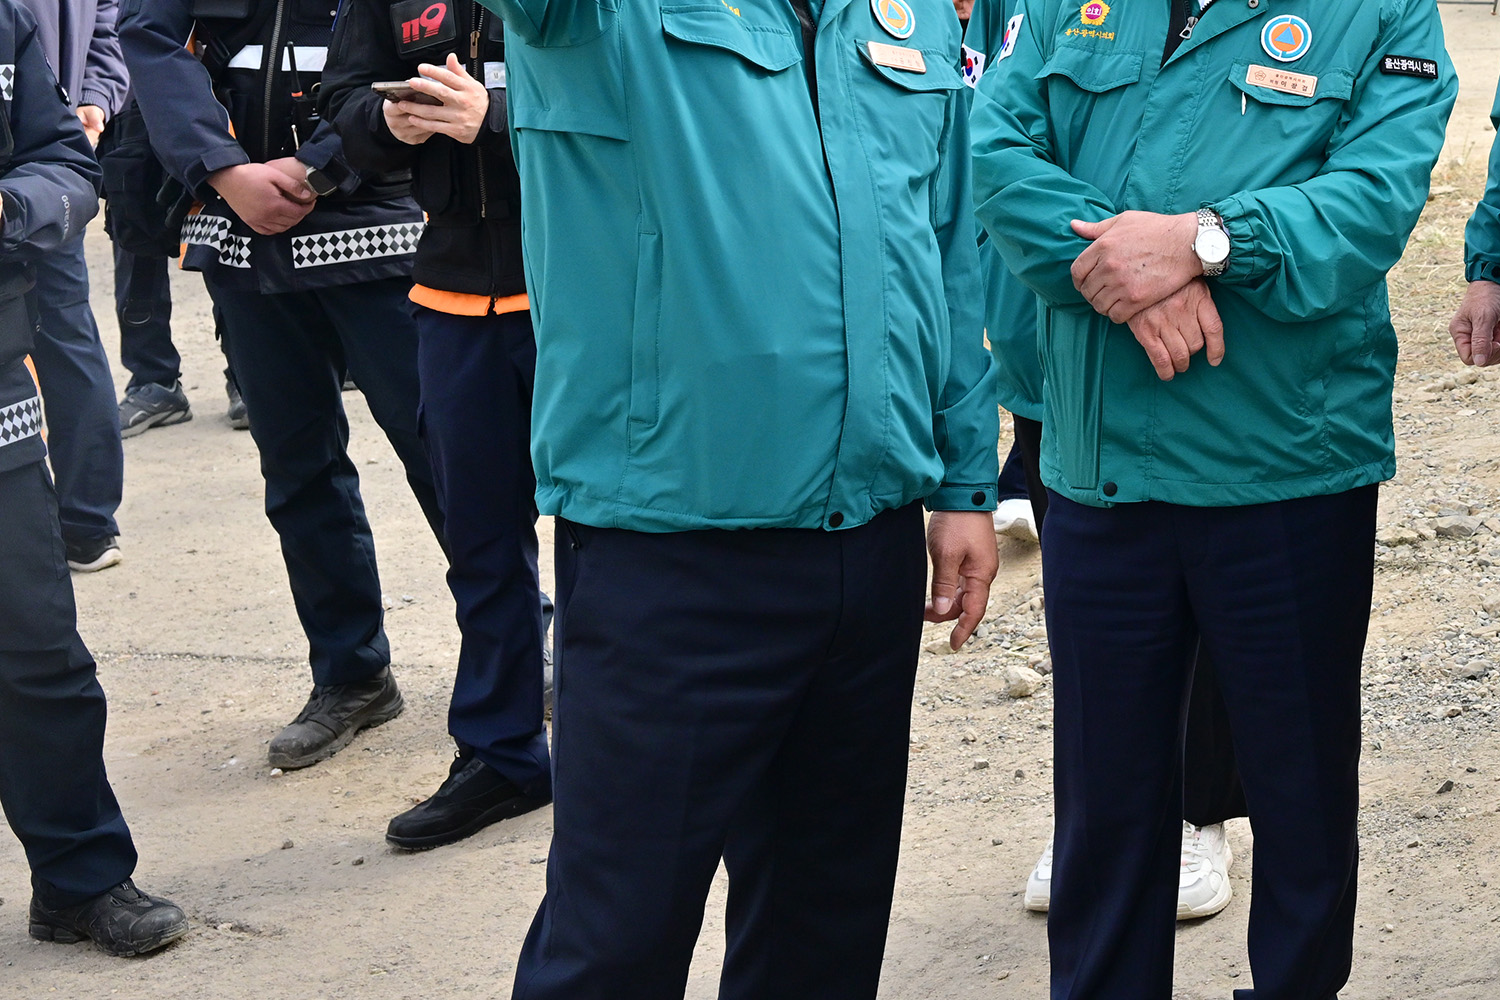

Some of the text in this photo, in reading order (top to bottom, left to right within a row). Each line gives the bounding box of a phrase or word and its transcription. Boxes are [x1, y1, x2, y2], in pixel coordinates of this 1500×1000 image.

[401, 2, 447, 44] 119
[1385, 57, 1436, 76] 울산광역시 의회
